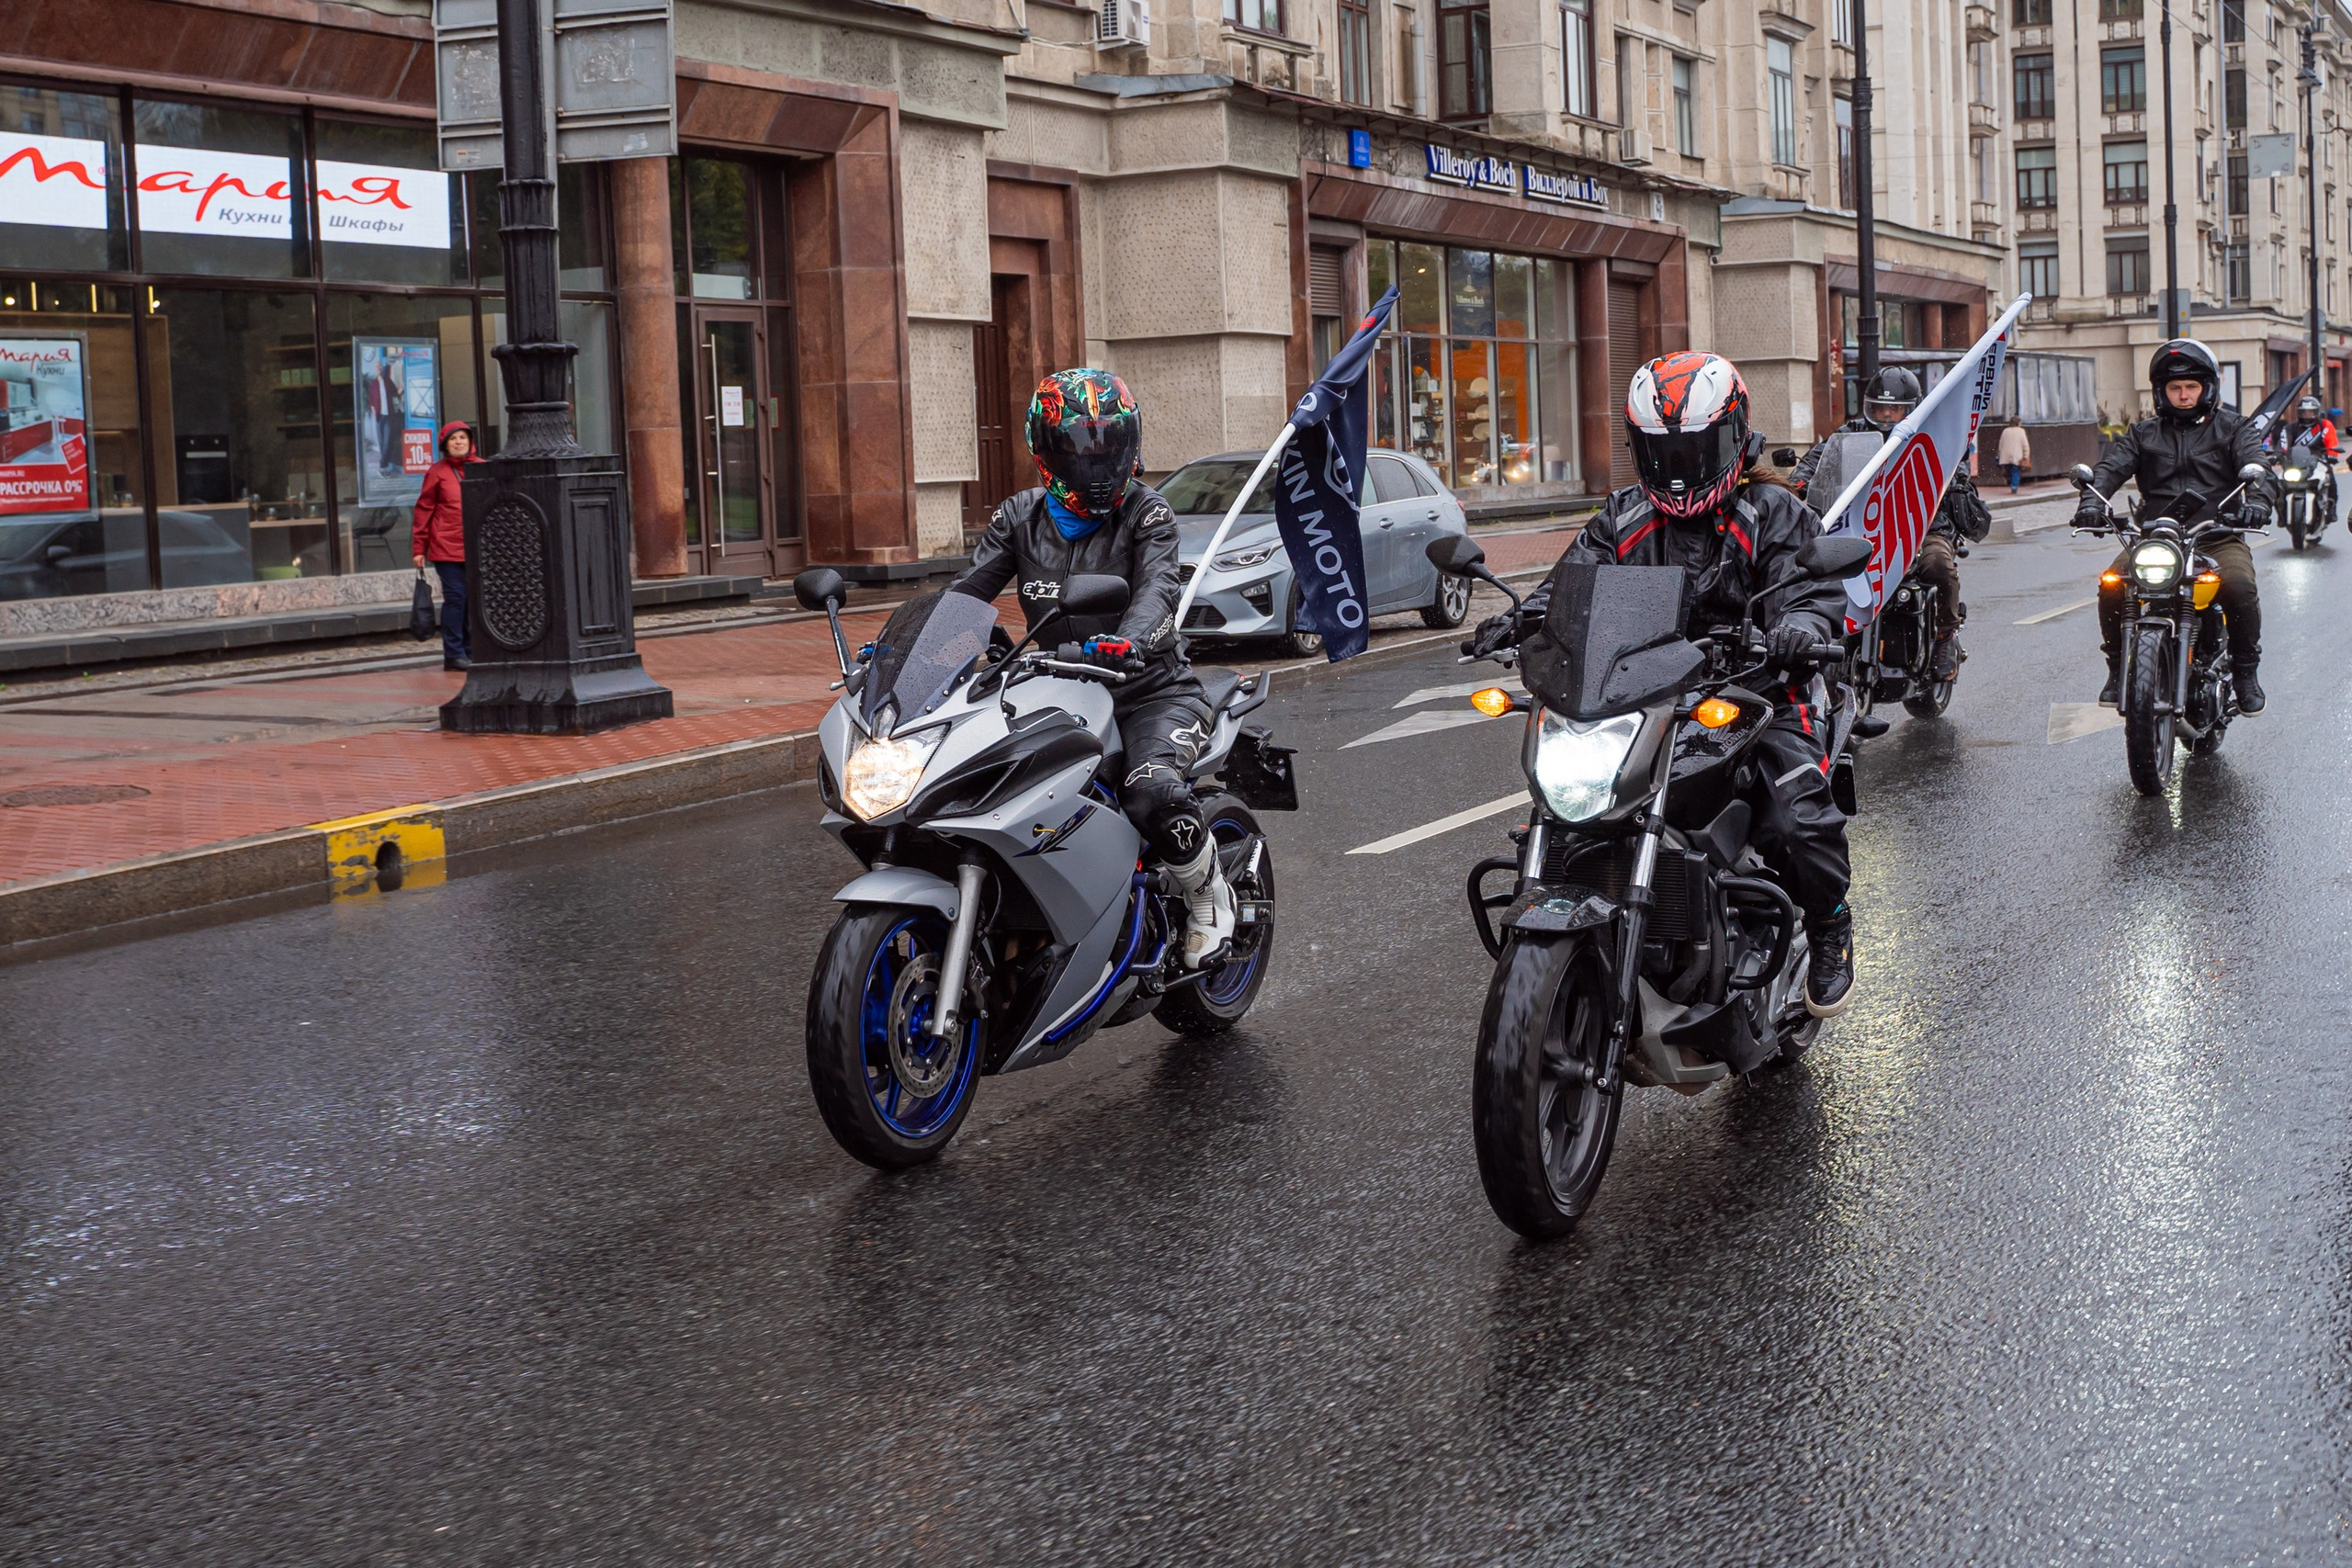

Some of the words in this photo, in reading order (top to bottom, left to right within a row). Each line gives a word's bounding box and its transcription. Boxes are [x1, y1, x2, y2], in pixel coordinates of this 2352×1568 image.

[1429, 144, 1480, 187] Villeroy
[1478, 160, 1487, 182] &
[1488, 156, 1517, 187] Boch
[1527, 164, 1580, 203] Виллерой
[1582, 182, 1589, 200] и
[1590, 177, 1609, 204] Бох
[218, 208, 282, 226] Кухни
[328, 215, 405, 232] Шкафы
[0, 479, 62, 496] РАССРОЧКА
[1298, 507, 1364, 629] MOTO
[1718, 728, 1749, 752] HONDA
